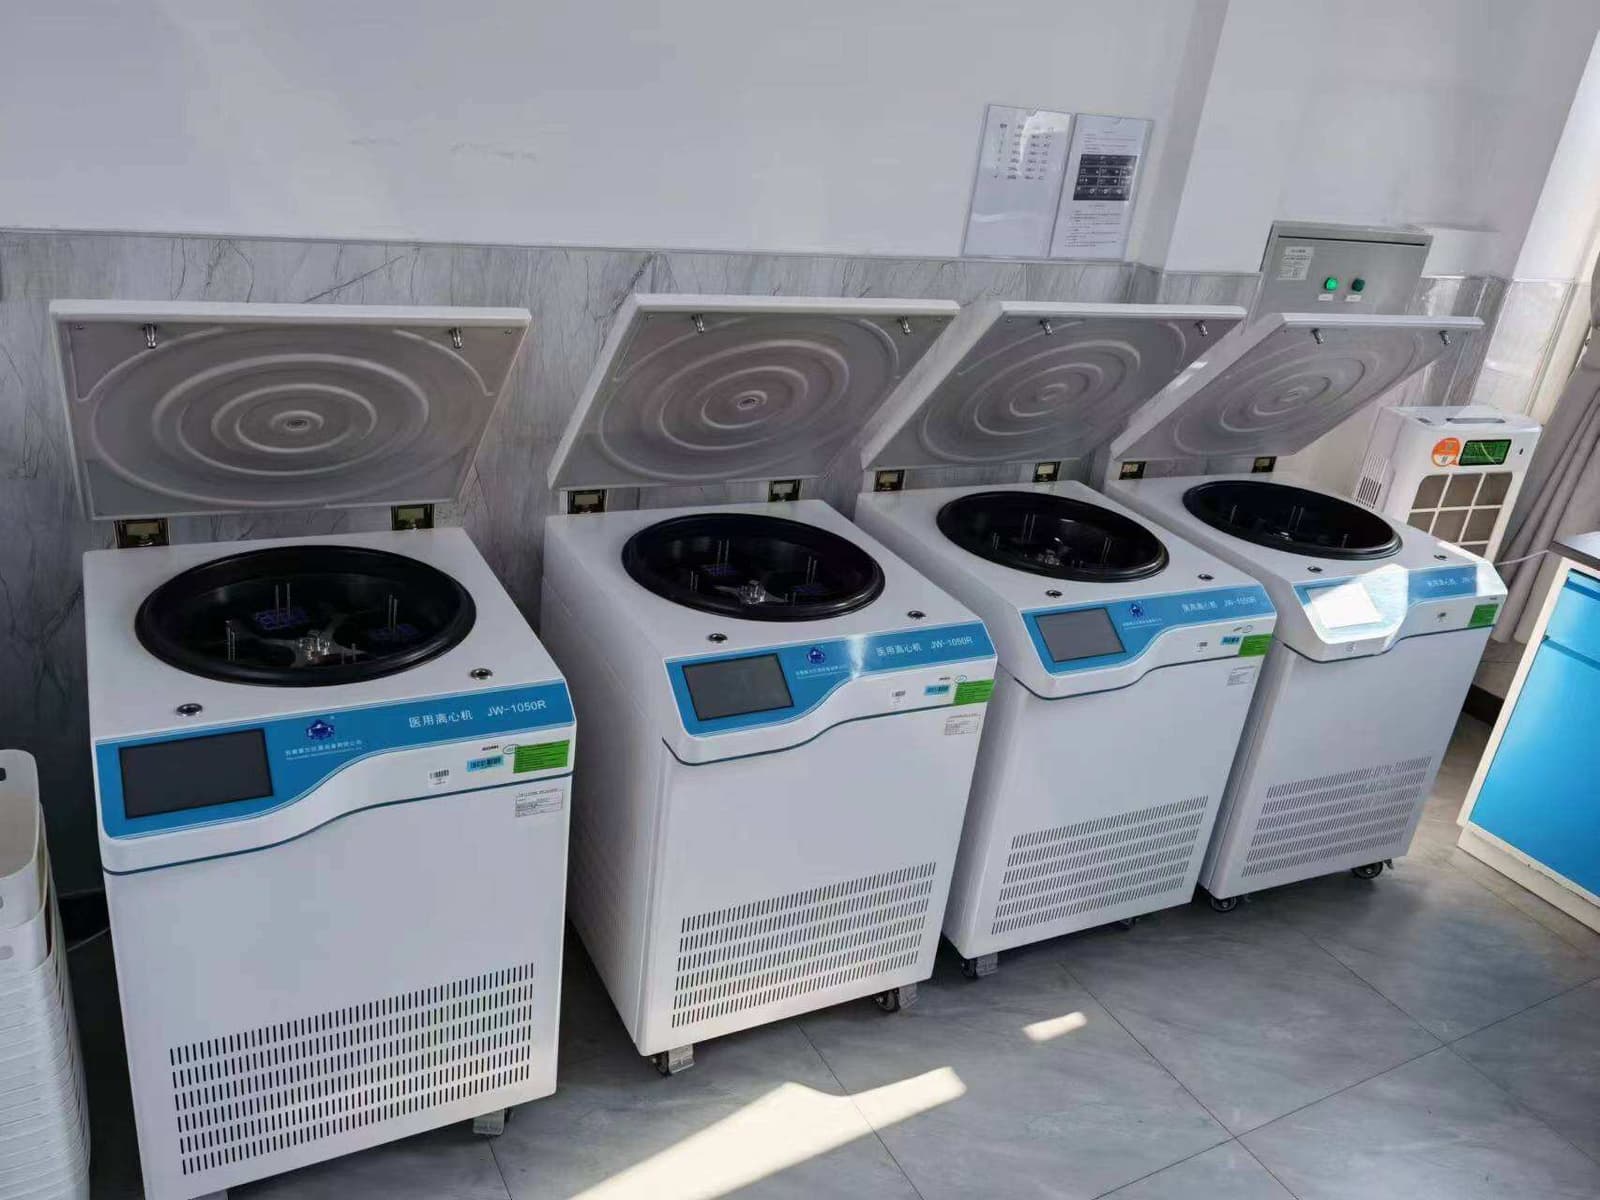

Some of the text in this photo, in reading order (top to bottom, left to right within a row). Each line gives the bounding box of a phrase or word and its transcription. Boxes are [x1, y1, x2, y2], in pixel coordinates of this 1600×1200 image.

[408, 699, 546, 728] 医用离心机 JW-1050R
